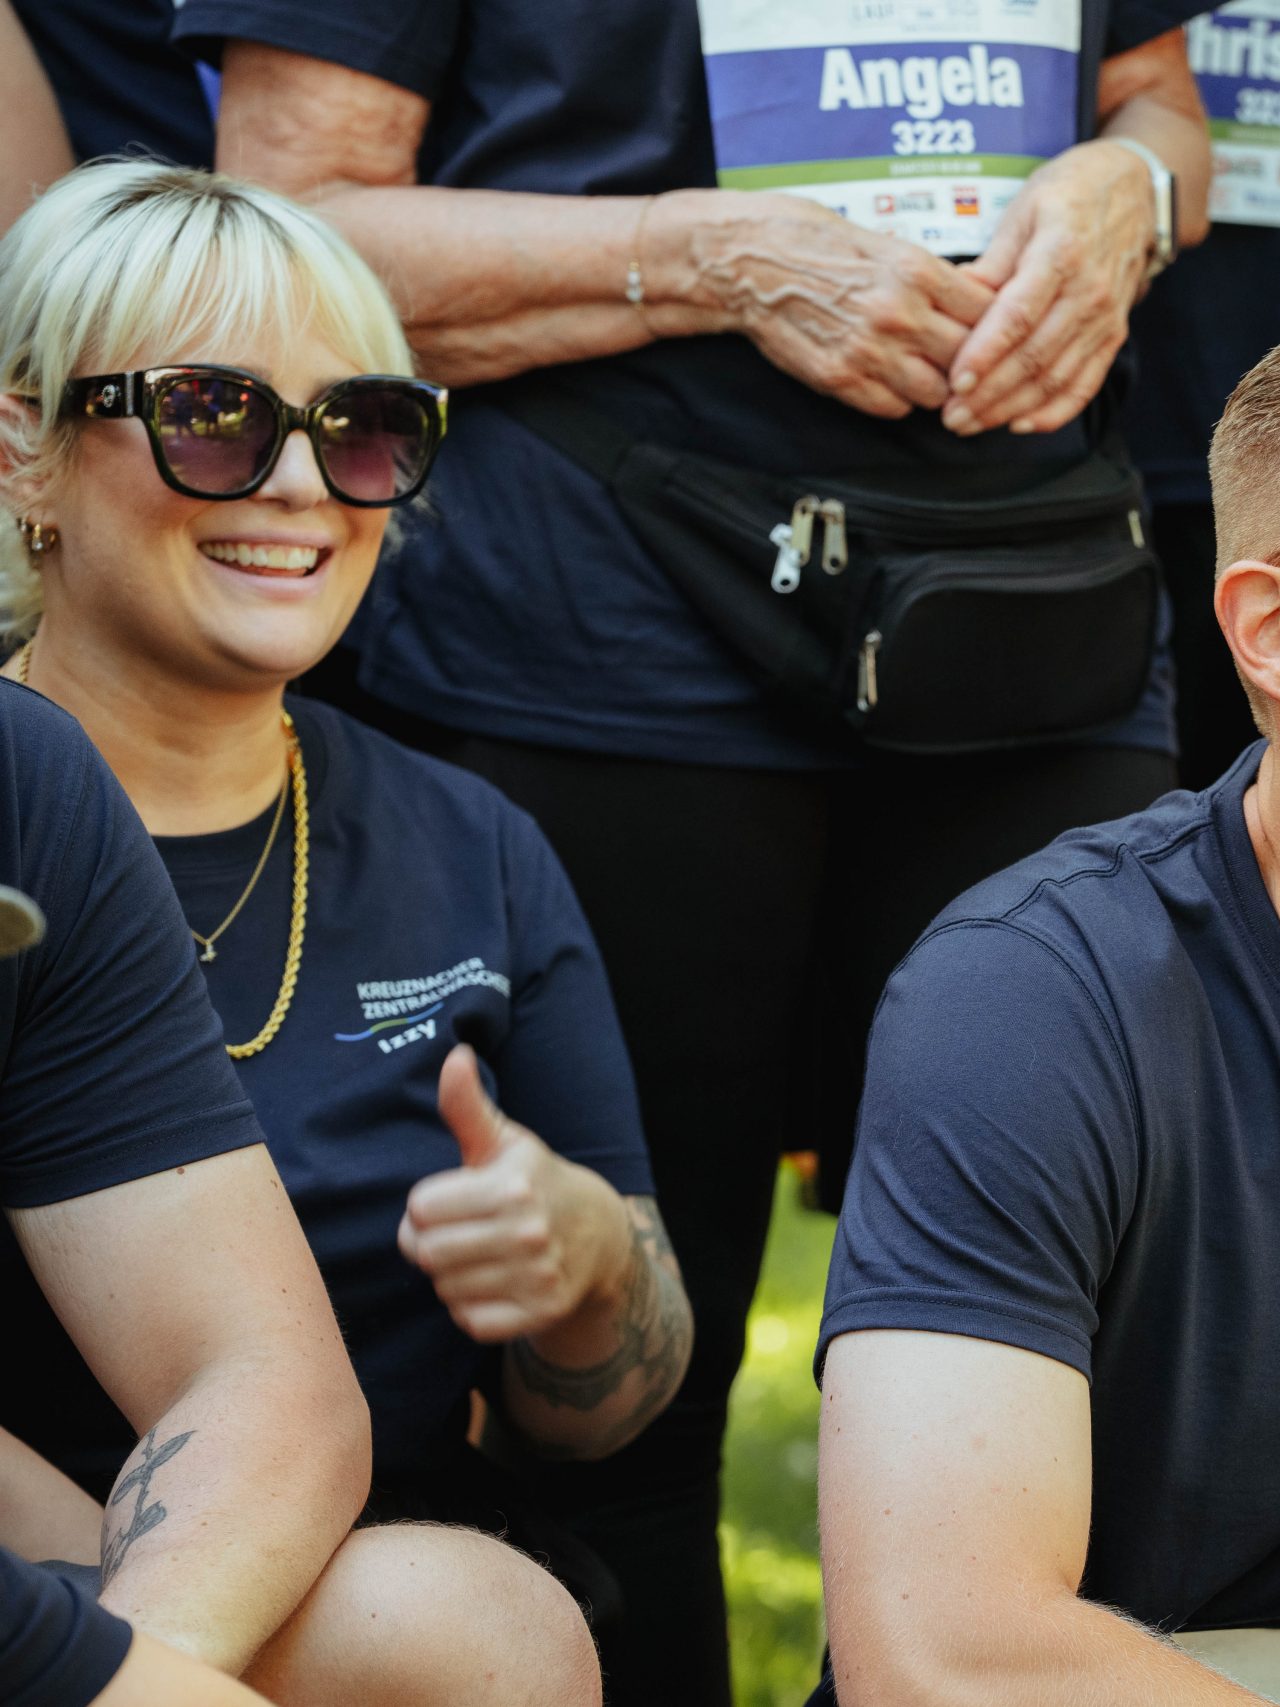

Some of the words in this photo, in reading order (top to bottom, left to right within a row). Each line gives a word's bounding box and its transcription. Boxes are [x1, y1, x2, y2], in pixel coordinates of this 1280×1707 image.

[818, 44, 1025, 119] Angela
[890, 119, 977, 154] 3223
[377, 1018, 437, 1055] Izzy
